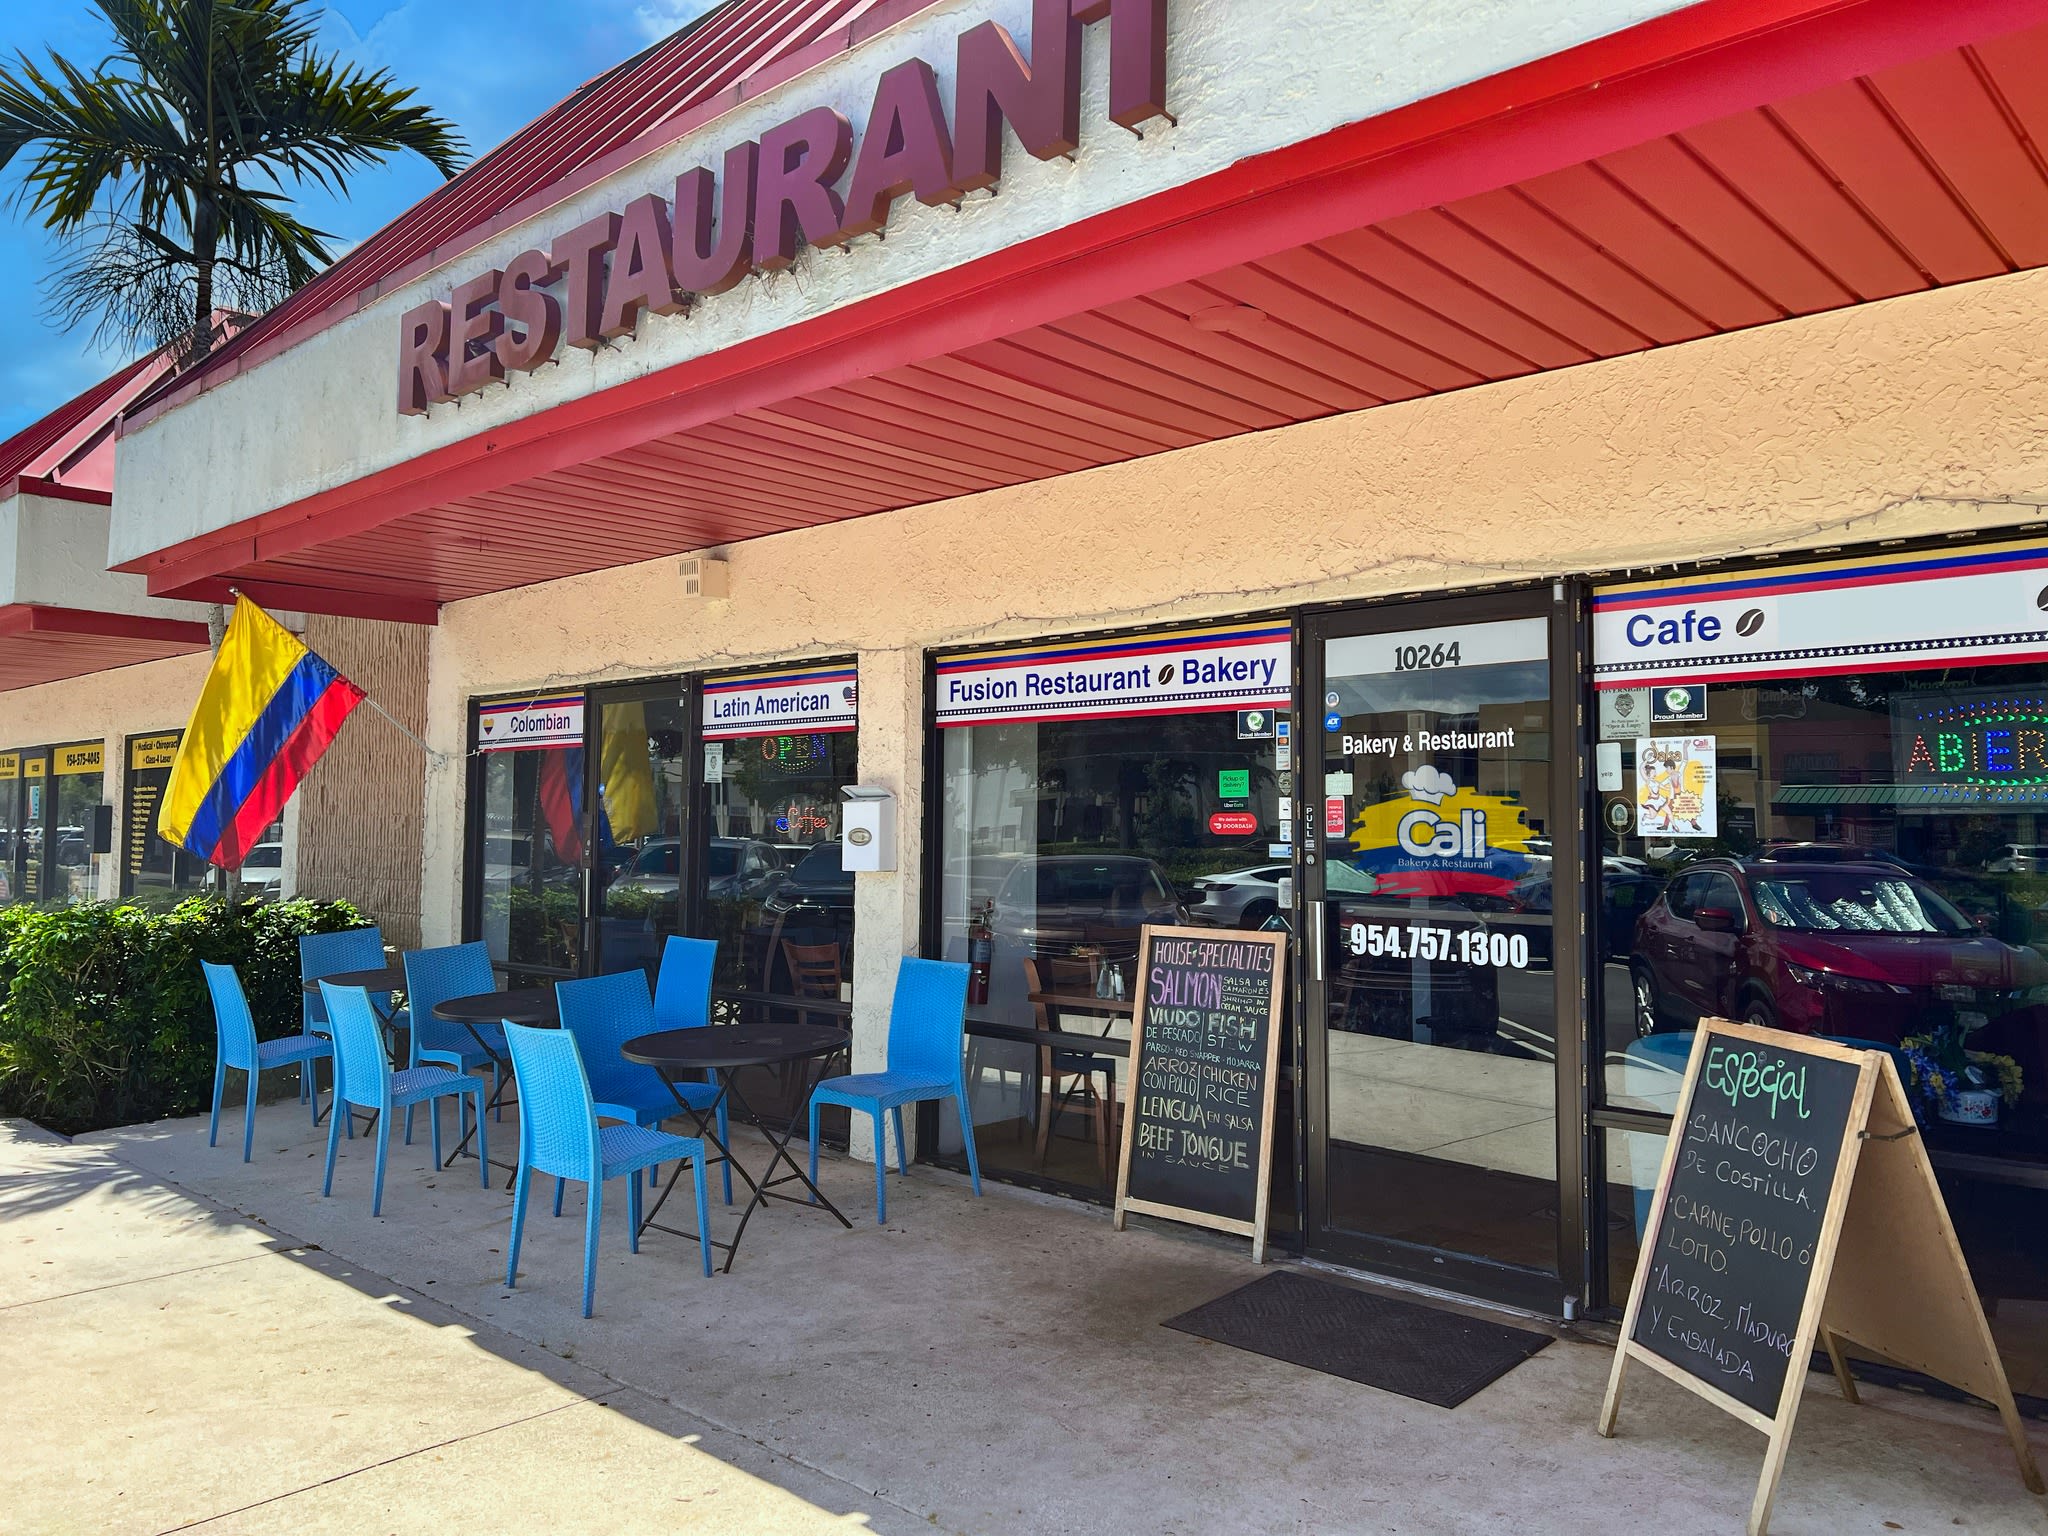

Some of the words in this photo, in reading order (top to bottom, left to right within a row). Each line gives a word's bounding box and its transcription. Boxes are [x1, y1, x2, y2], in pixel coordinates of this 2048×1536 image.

[400, 0, 1168, 416] RESTAURANT
[1626, 608, 1721, 648] Cafe
[1394, 641, 1461, 671] 10264
[949, 677, 1017, 702] Fusion
[1025, 663, 1151, 697] Restaurant
[1182, 655, 1278, 686] Bakery
[713, 696, 751, 719] Latin
[754, 691, 830, 715] American
[510, 713, 571, 733] Colombian
[761, 734, 827, 760] OPEN
[1342, 732, 1398, 758] Bakery
[1402, 735, 1414, 752] &
[1418, 727, 1515, 751] Restaurant
[66, 751, 100, 767] 954-575-4045
[787, 807, 829, 834] Coffee
[1305, 807, 1313, 838] PULL
[1396, 807, 1487, 860] Cali
[1397, 858, 1432, 870] Bakery
[1432, 858, 1441, 868] &
[1441, 857, 1493, 869] Restaurant
[1350, 922, 1529, 969] 954.757.1300
[1151, 966, 1222, 1010] SALMON
[1221, 985, 1269, 995] CAMARONES
[1223, 976, 1251, 987] SALSA
[1257, 979, 1269, 987] DE
[1149, 1006, 1200, 1028] VIUDO
[1220, 1002, 1241, 1013] CREAM
[1244, 1005, 1268, 1016] SAUCE
[1146, 1026, 1158, 1039] DE
[1162, 1028, 1200, 1044] PESCADO
[1208, 1011, 1257, 1041] FISH
[1207, 1034, 1253, 1053] STW
[1144, 1056, 1199, 1078] ARROZ
[1175, 1046, 1188, 1058] RED
[1190, 1049, 1221, 1063] SNAPPER
[1226, 1055, 1261, 1071] MOJARRA
[1142, 1071, 1166, 1091] CON
[1168, 1073, 1197, 1097] POLLO
[1203, 1064, 1257, 1092] CHICKEN
[1205, 1084, 1251, 1108] RICE
[1141, 1096, 1207, 1130] LENGUA
[1207, 1110, 1221, 1124] EN
[1224, 1113, 1254, 1132] SALSA
[1138, 1122, 1175, 1151] BEEF
[1181, 1129, 1249, 1170] TONGUE
[1688, 1114, 1818, 1176] SANCOCHO
[1142, 1151, 1155, 1160] IN
[1165, 1154, 1230, 1174] SAUCE
[1682, 1150, 1707, 1174] DE
[1650, 1304, 1664, 1335] Y
